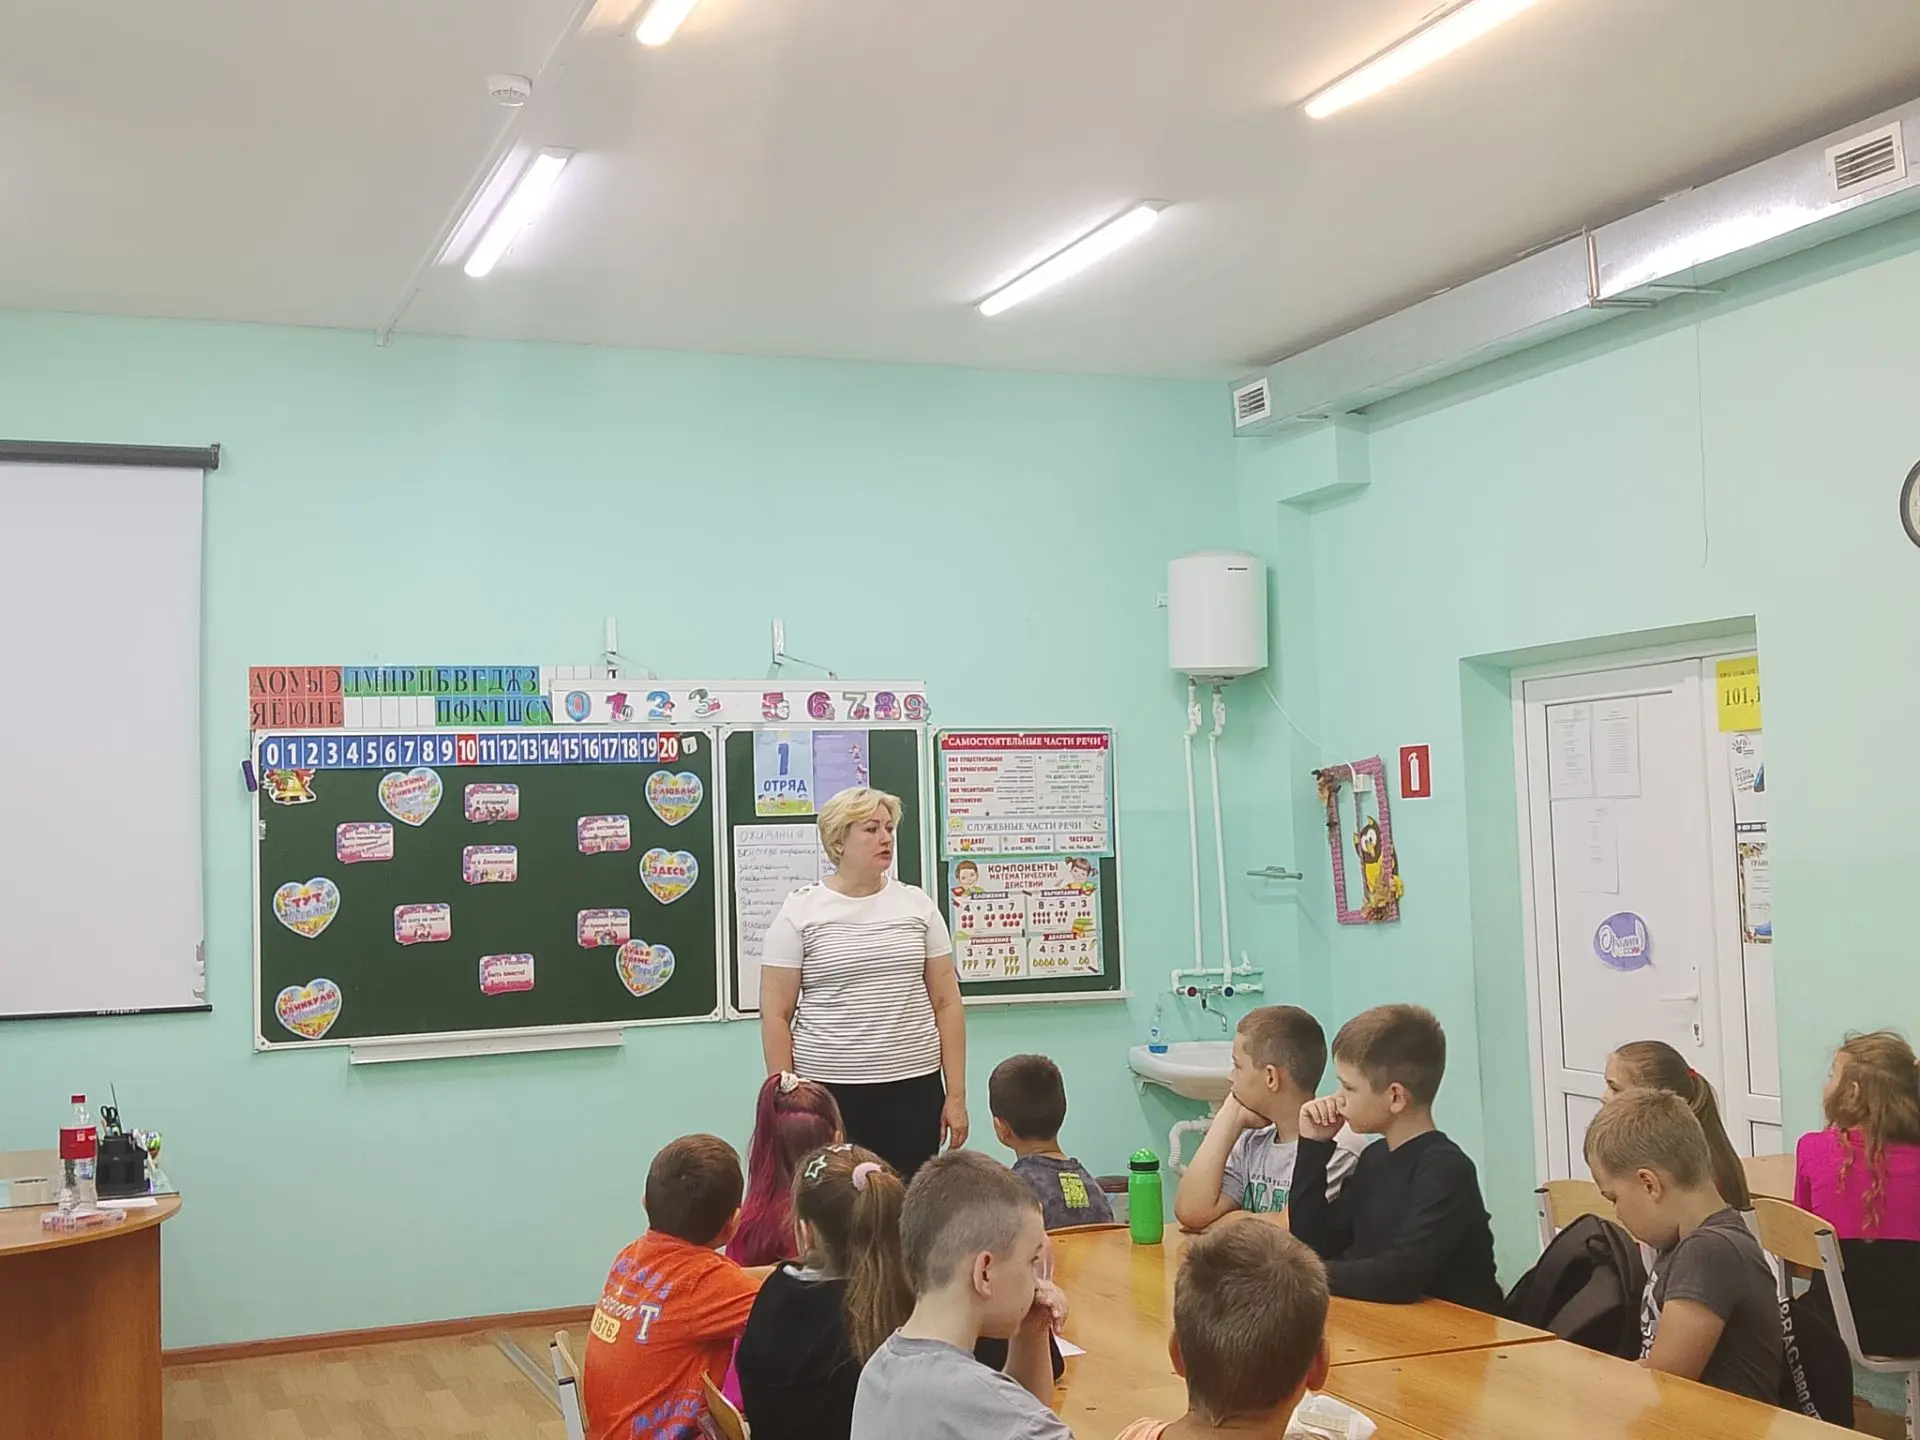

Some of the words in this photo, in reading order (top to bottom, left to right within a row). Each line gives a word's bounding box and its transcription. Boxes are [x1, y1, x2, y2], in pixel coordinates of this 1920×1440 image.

[647, 691, 674, 720] 2
[807, 691, 833, 720] 6
[842, 692, 868, 720] 7
[948, 736, 1042, 746] САМОСТОЯТЕЛЬНЫЕ
[1045, 736, 1075, 746] ЧАСТИ
[1077, 736, 1101, 745] РЕЧИ
[267, 744, 279, 765] 0
[288, 743, 297, 765] 1
[307, 743, 319, 764] 2
[327, 743, 338, 764] 3
[346, 742, 359, 764] 4
[366, 742, 377, 764] 5
[385, 741, 396, 763] 6
[404, 741, 415, 763] 7
[422, 740, 434, 762] 8
[441, 740, 453, 761] 9
[458, 739, 477, 760] 10
[479, 739, 496, 761] 11
[500, 739, 517, 761] 12
[520, 739, 538, 760] 13
[541, 739, 559, 760] 14
[562, 739, 579, 760] 15
[582, 738, 599, 759] 16
[601, 738, 618, 759] 17
[621, 738, 638, 758] 18
[641, 737, 657, 758] 19
[659, 737, 678, 758] 20
[778, 743, 789, 776] 1
[763, 779, 807, 794] ОТРЯД
[967, 822, 1025, 832] СЛУЖЕБНЫЕ
[1026, 822, 1057, 830] ЧАСТИ
[1059, 821, 1081, 830] РЕЧИ
[652, 866, 685, 876] ЗДЕСЬ
[988, 863, 1058, 873] КОМПОНЕНТЫ
[989, 872, 1057, 881] МАТЕМАТИЧЕСКИХ
[1004, 880, 1044, 889] ДЕЙСТВИЙ
[292, 892, 322, 908] ТУТ
[593, 1313, 616, 1338] 1976
